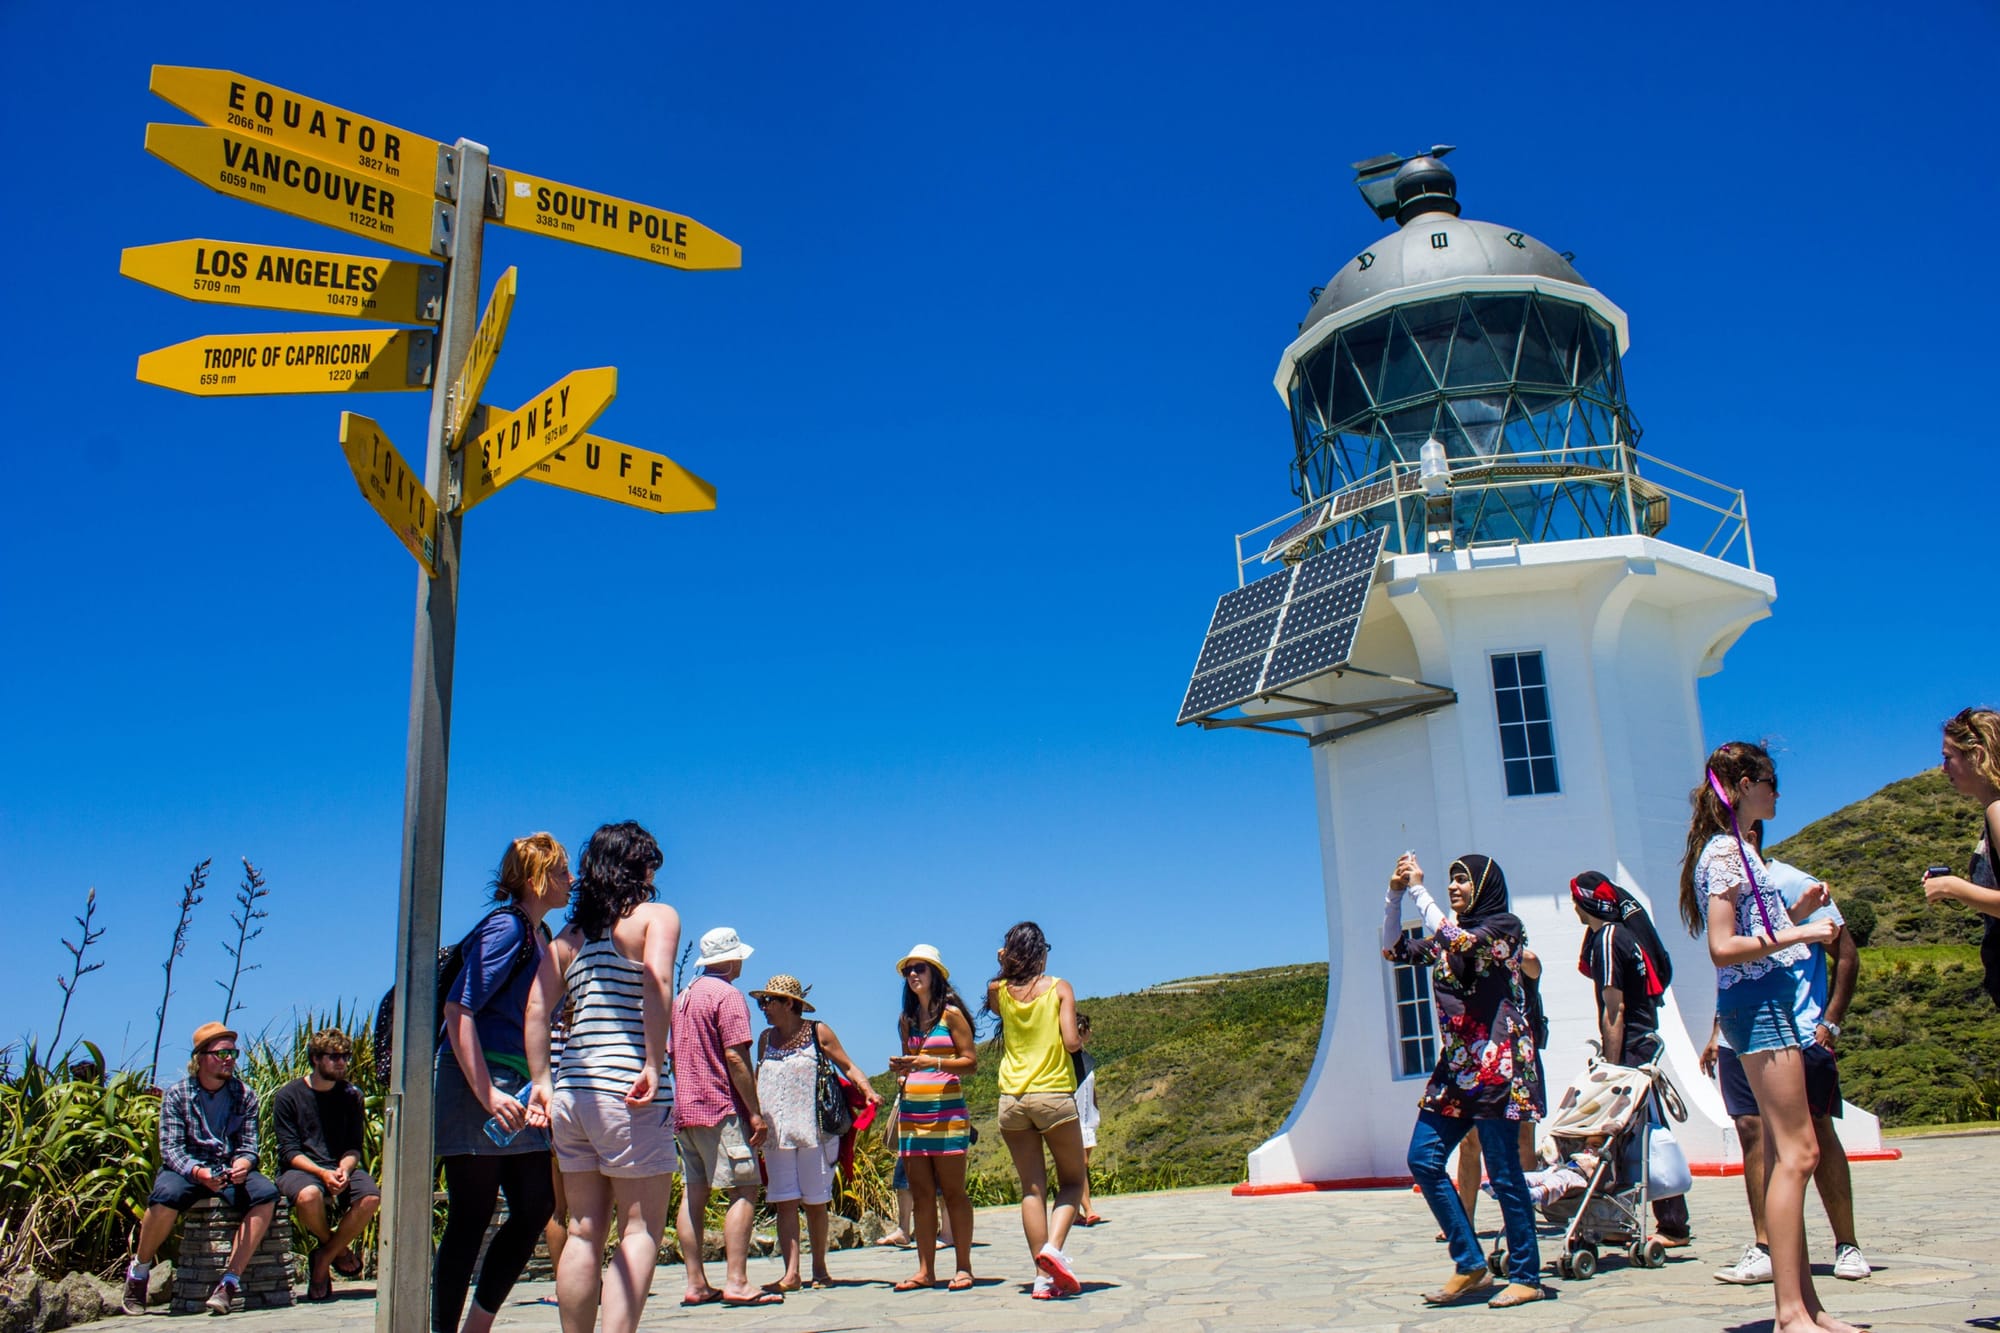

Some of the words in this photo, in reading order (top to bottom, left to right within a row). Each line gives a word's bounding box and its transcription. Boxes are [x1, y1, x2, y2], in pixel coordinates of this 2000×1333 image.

[227, 112, 255, 130] 2066
[257, 123, 273, 136] nm
[229, 82, 401, 162] EQUATOR
[359, 155, 384, 174] 3827
[385, 161, 400, 177] km
[220, 171, 247, 188] 6059
[250, 181, 266, 195] nm
[223, 138, 395, 219] VANCOUVER
[350, 211, 377, 230] 11222
[380, 219, 394, 234] km
[536, 187, 618, 229] SOUTH
[628, 210, 687, 247] POLE
[536, 214, 559, 228] 3383
[561, 222, 575, 232] nm
[650, 243, 670, 257] 6211
[674, 248, 687, 260] km
[195, 248, 248, 278] LOS
[255, 255, 378, 292] ANGELES
[193, 279, 221, 293] 5709
[224, 284, 241, 295] nm
[327, 293, 358, 307] 10479
[361, 295, 377, 309] km
[204, 347, 256, 369] TROPIC
[262, 346, 281, 367] OF
[285, 343, 371, 366] CAPRICORN
[200, 374, 218, 385] 659
[220, 374, 236, 384] nm
[328, 369, 352, 381] 1220
[355, 369, 369, 380] km
[482, 385, 570, 469] SYDNEY
[560, 424, 568, 436] km
[373, 433, 426, 528] TOKYO
[628, 485, 648, 499] 1452
[650, 490, 662, 503] km
